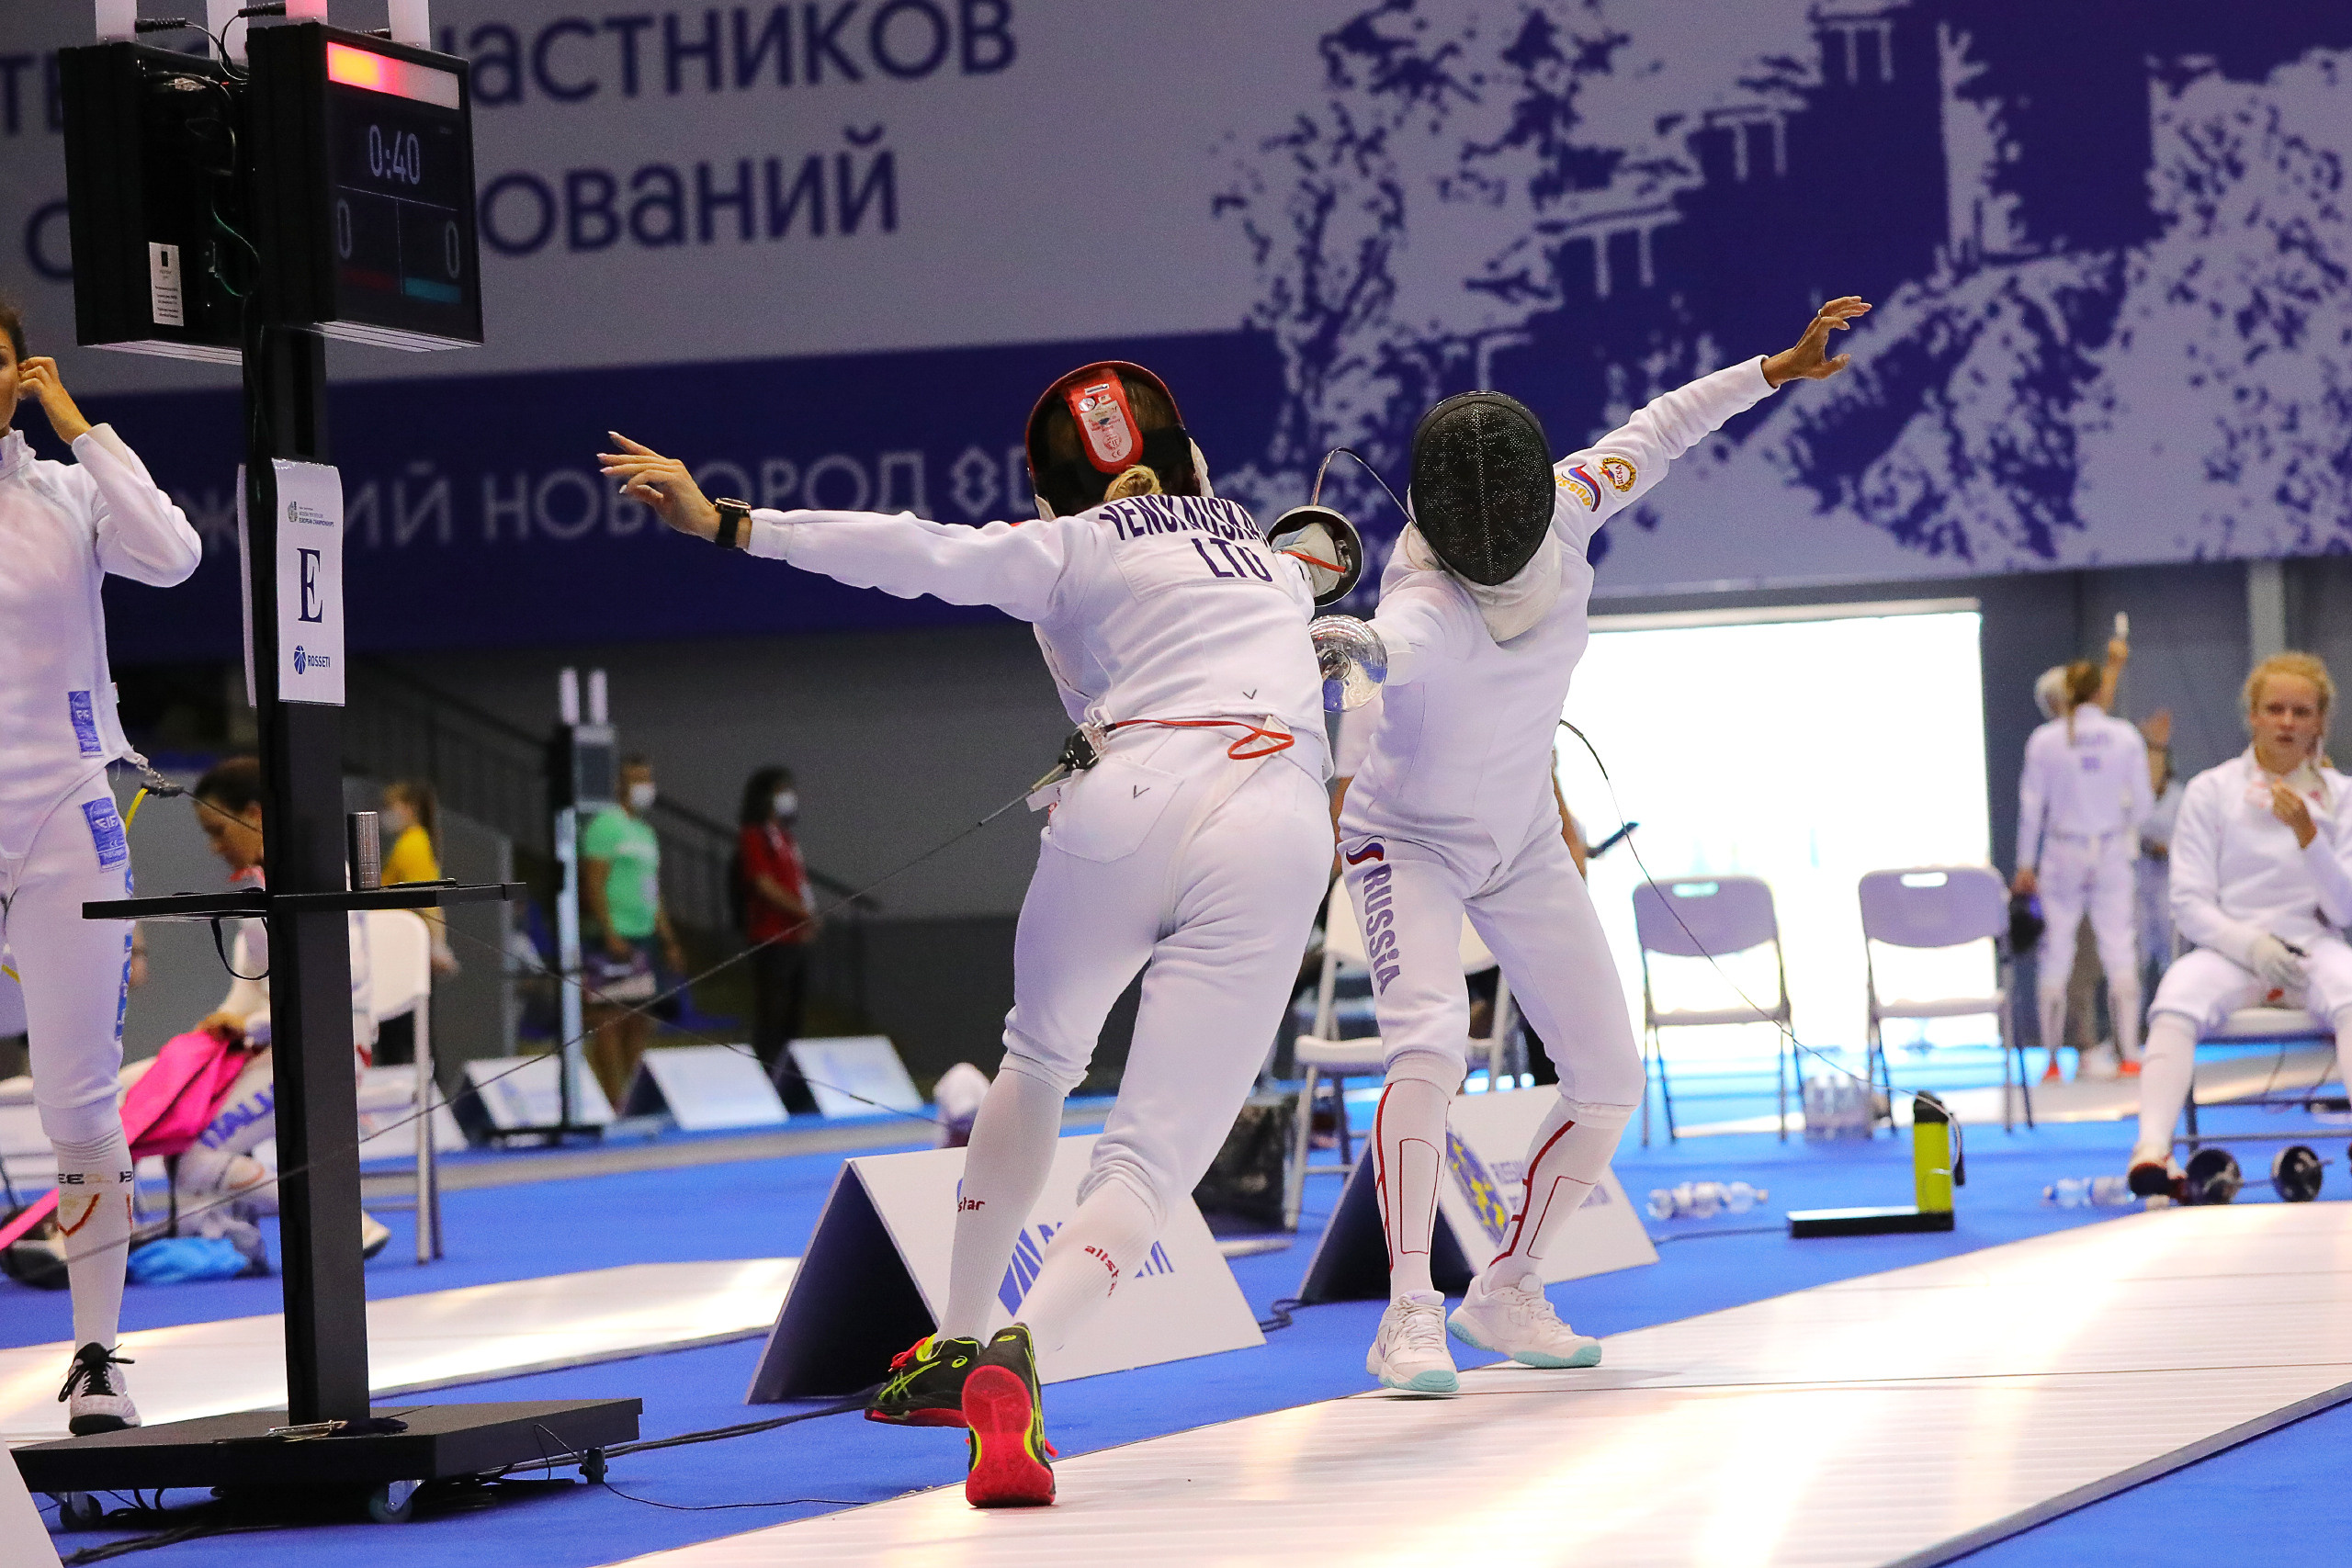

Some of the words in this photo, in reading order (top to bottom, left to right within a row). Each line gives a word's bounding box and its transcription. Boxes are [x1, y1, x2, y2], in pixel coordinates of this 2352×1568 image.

[369, 124, 421, 185] 0:40
[1191, 538, 1273, 582] LTU
[297, 547, 323, 624] E
[307, 655, 331, 668] ROSSETI
[957, 1196, 985, 1213] star
